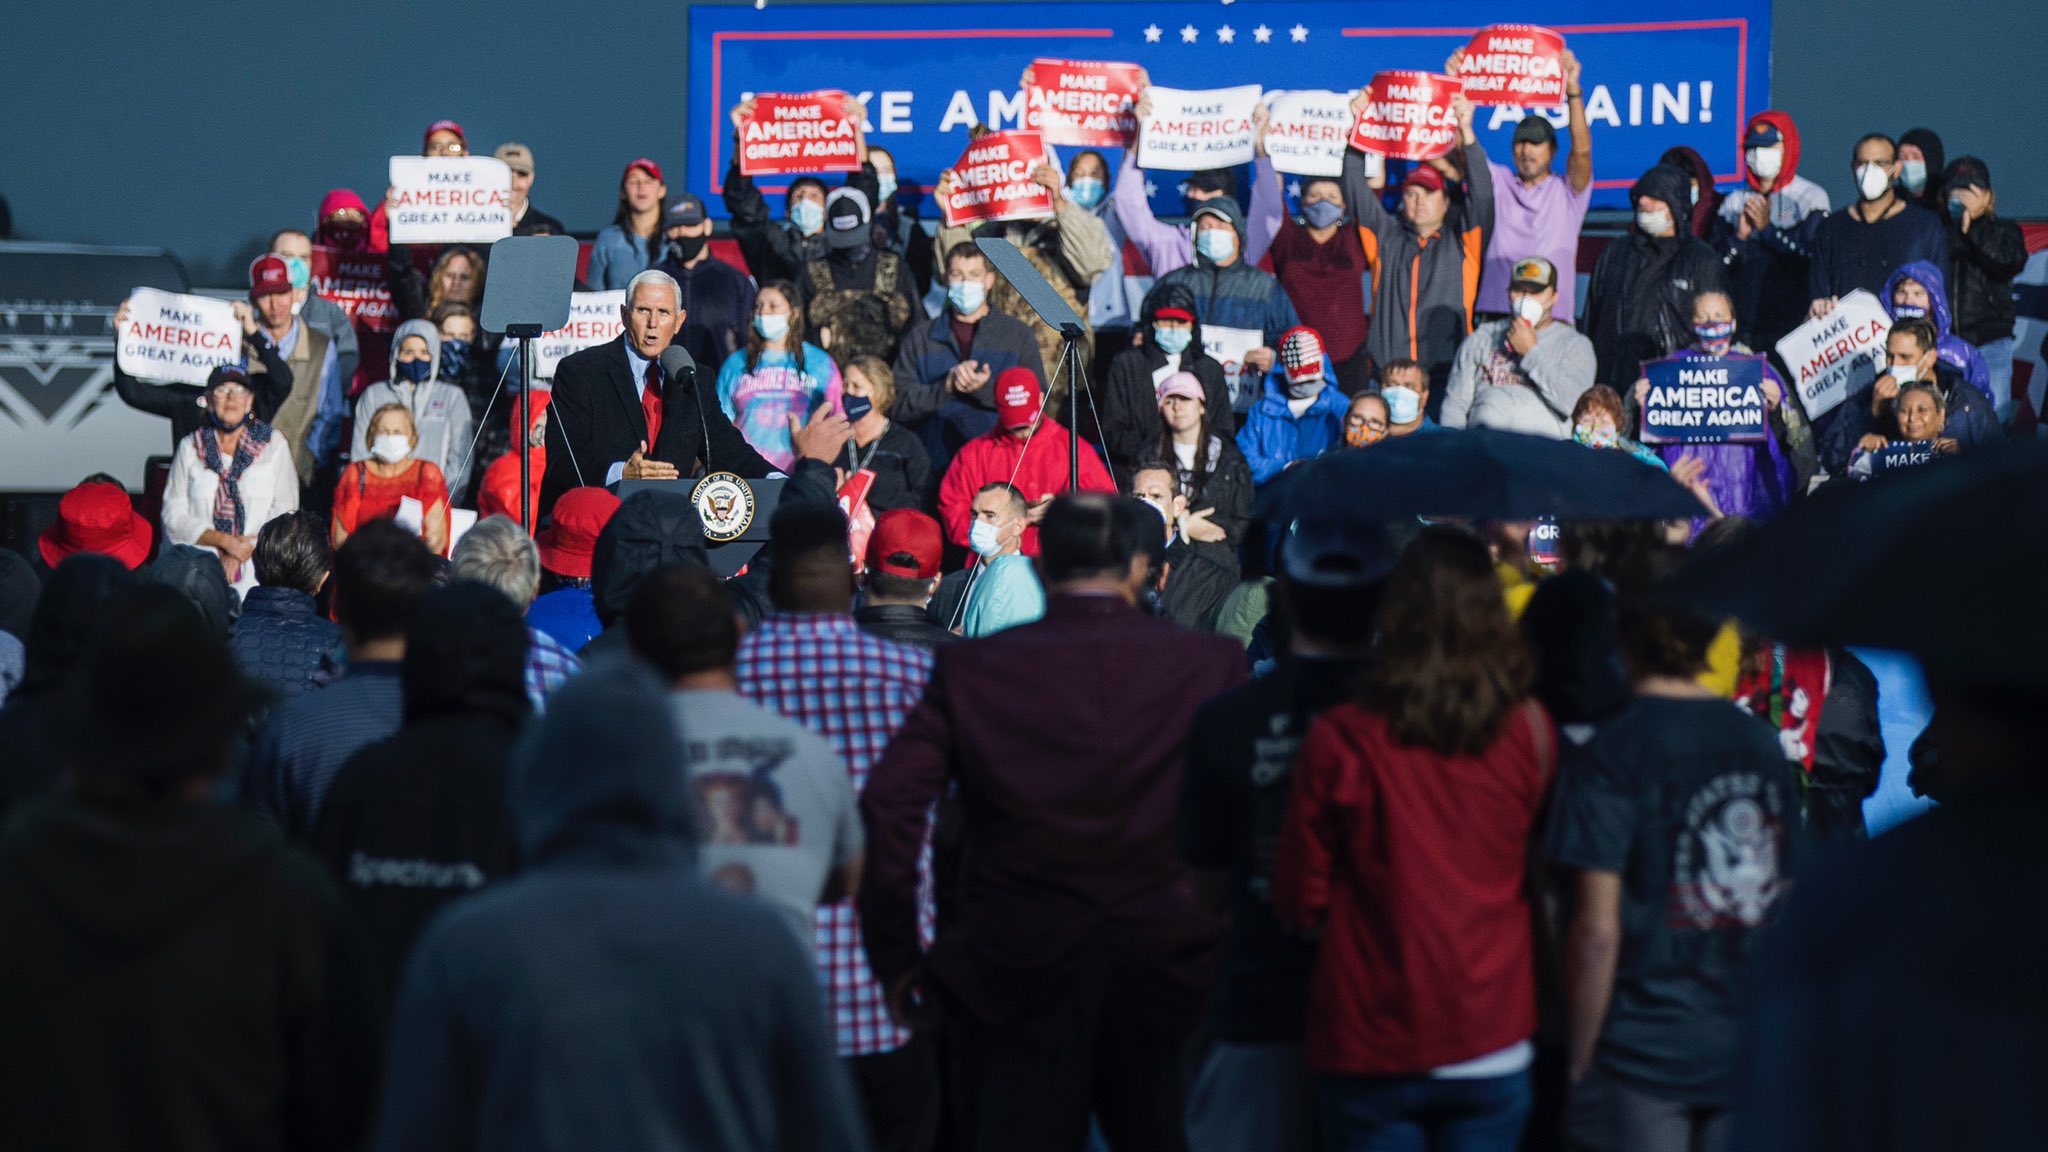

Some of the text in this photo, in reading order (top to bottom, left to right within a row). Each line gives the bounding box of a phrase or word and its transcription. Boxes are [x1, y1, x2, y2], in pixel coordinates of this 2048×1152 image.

[1488, 37, 1534, 54] MAKE
[1460, 54, 1561, 78] AMERICA
[1060, 74, 1108, 90] MAKE
[1508, 79, 1560, 96] AGAIN
[1029, 86, 1135, 114] AMERICA
[1387, 84, 1433, 102] MAKE
[774, 105, 822, 120] MAKE
[1181, 103, 1224, 117] MAKE
[1302, 107, 1345, 120] MAKE
[1361, 102, 1458, 127] AMERICA
[745, 119, 854, 142] AMERICA
[1028, 111, 1082, 128] GREAT
[1082, 113, 1137, 132] AGAIN
[1150, 119, 1251, 138] AMERICA
[1358, 123, 1406, 142] GREAT
[746, 140, 856, 160] GREAT AGAIN
[968, 144, 1010, 165] MAKE
[1147, 137, 1250, 153] GREAT AGAIN
[1271, 143, 1319, 158] GREAT
[428, 171, 472, 184] MAKE
[400, 189, 502, 207] AMERICA
[950, 180, 1046, 209] GREAT AGAIN
[398, 211, 505, 225] GREAT AGAIN
[160, 307, 203, 326] MAKE
[129, 321, 232, 350] AMERICA
[1812, 316, 1850, 349] MAKE
[125, 344, 176, 363] GREAT
[1800, 319, 1887, 384] AMERICA
[1679, 369, 1728, 385] MAKE
[1806, 365, 1848, 400] GREAT
[1647, 385, 1761, 408] AMERICA
[1647, 409, 1762, 426] GREAT AGAIN
[722, 474, 734, 482] THE
[735, 479, 753, 507] UNITED
[731, 510, 752, 535] STATES
